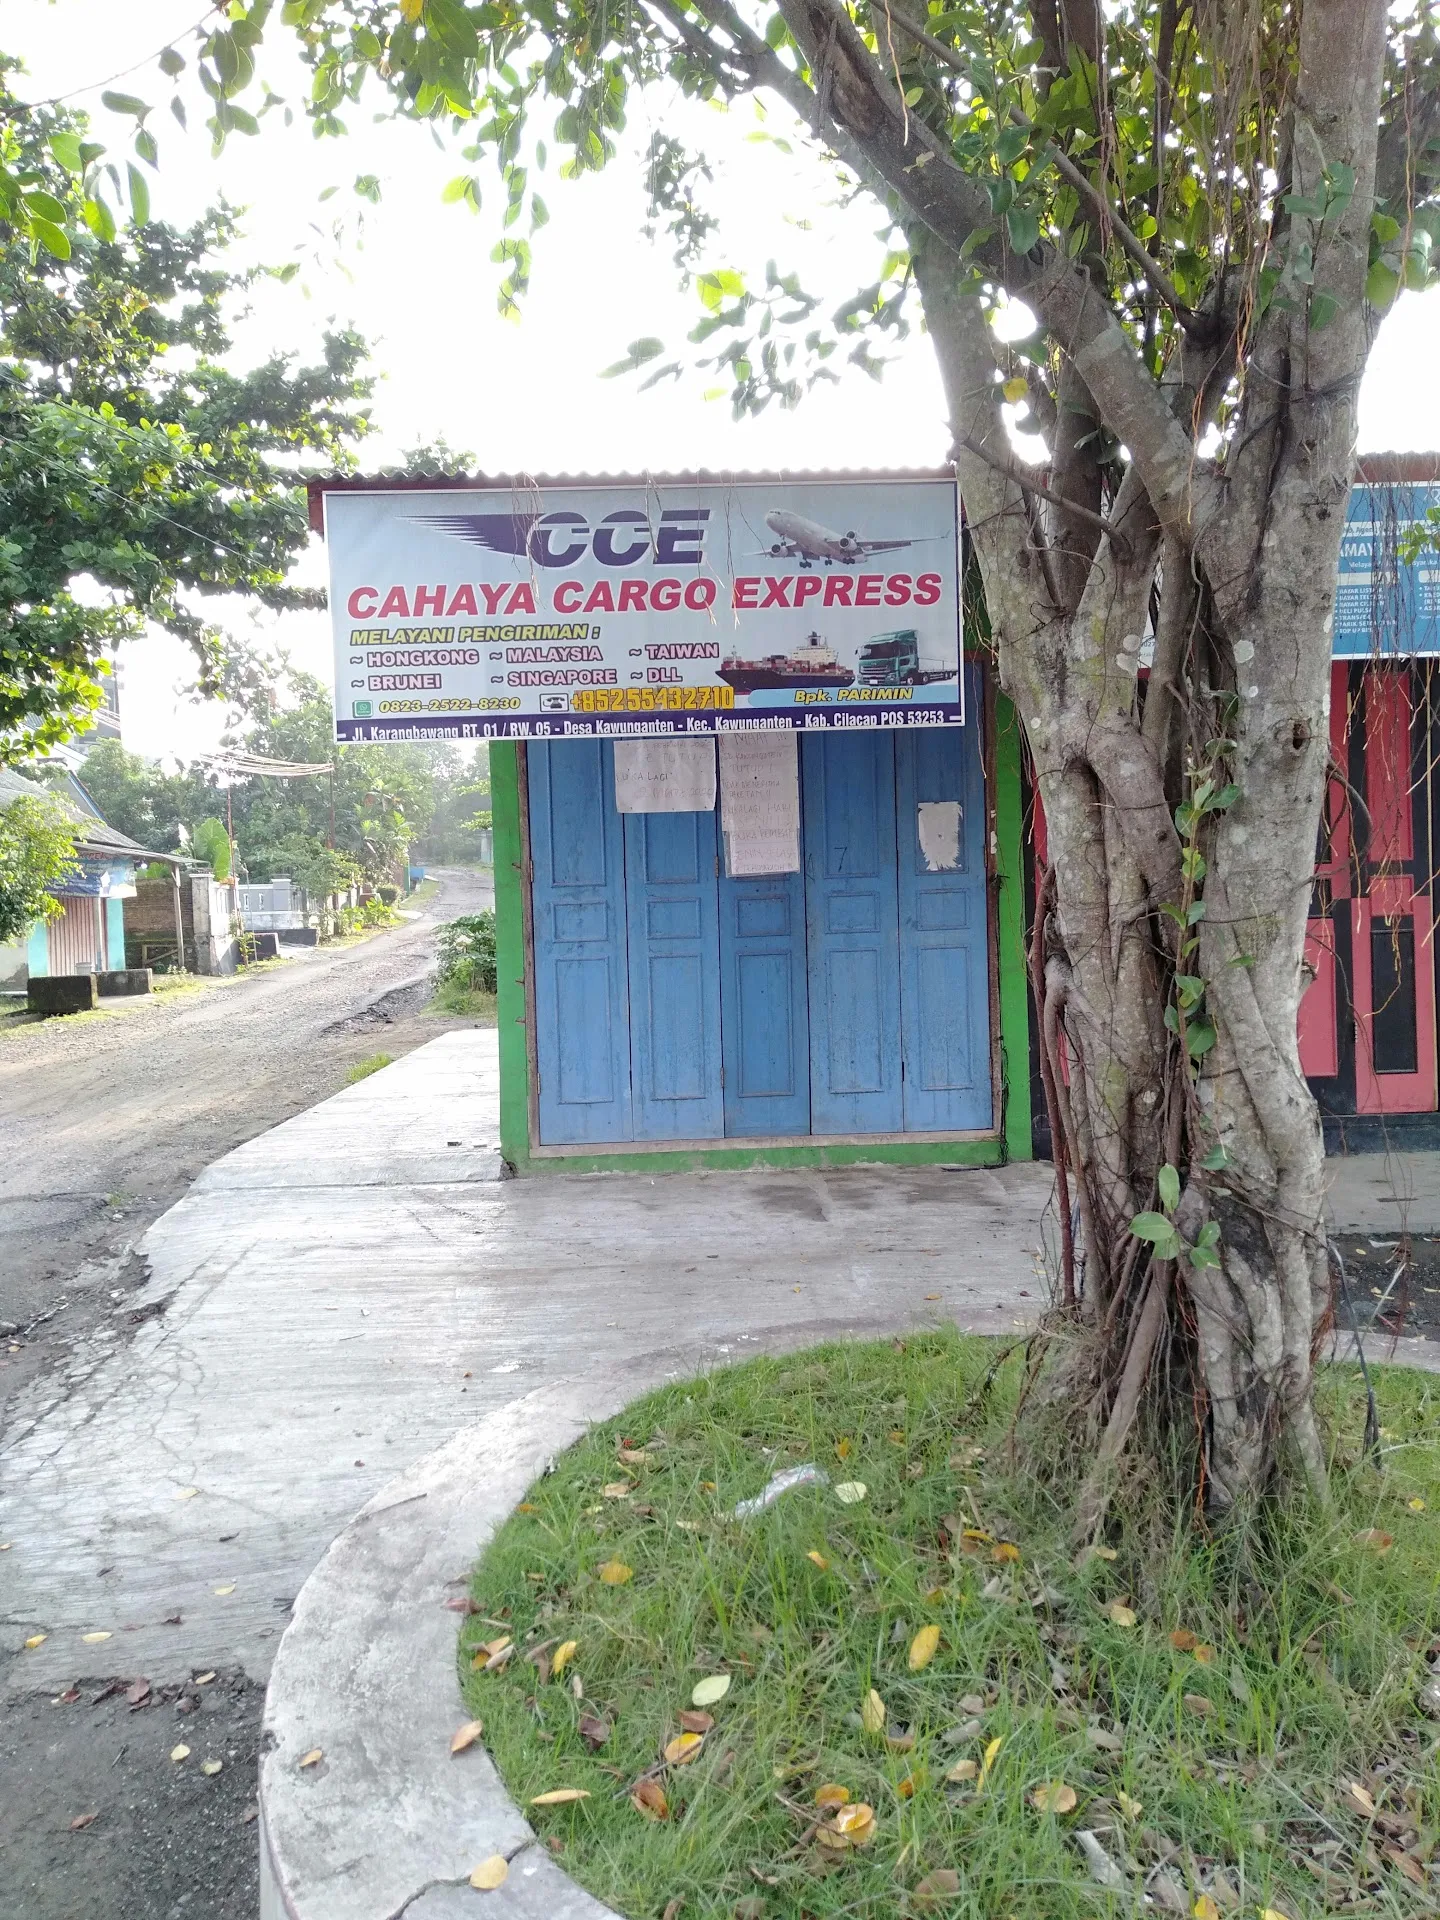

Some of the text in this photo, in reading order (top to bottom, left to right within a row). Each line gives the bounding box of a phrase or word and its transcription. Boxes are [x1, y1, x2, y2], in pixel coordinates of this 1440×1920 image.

[528, 509, 712, 568] CCE
[347, 572, 942, 619] CAHAYA CARGO EXPRESS
[350, 626, 455, 646] MELAYANI
[458, 624, 589, 643] PENGIRIMAN
[367, 649, 480, 668] HONGKONG
[506, 646, 604, 664] MALAYSIA
[645, 642, 720, 660] TAIWAN
[368, 673, 443, 692] BRUNEI
[507, 668, 618, 687] SINGAPORE
[646, 667, 683, 684] DLL
[379, 696, 521, 714] 0823-2522-8230
[794, 687, 914, 704] Bpk. PARIMIN
[370, 725, 459, 741] Karangbawang
[462, 723, 480, 738] RT.
[483, 722, 498, 737] 01
[510, 721, 533, 737] RW.
[535, 720, 551, 736] 05
[563, 720, 593, 736] Desa
[595, 717, 674, 735] Kawunganten
[686, 716, 712, 731] Kec.
[715, 714, 793, 730] Kawunganten
[804, 713, 831, 728] Kab.
[833, 711, 877, 727] Cilacap
[880, 711, 905, 726] POS
[907, 710, 944, 724] 53253
